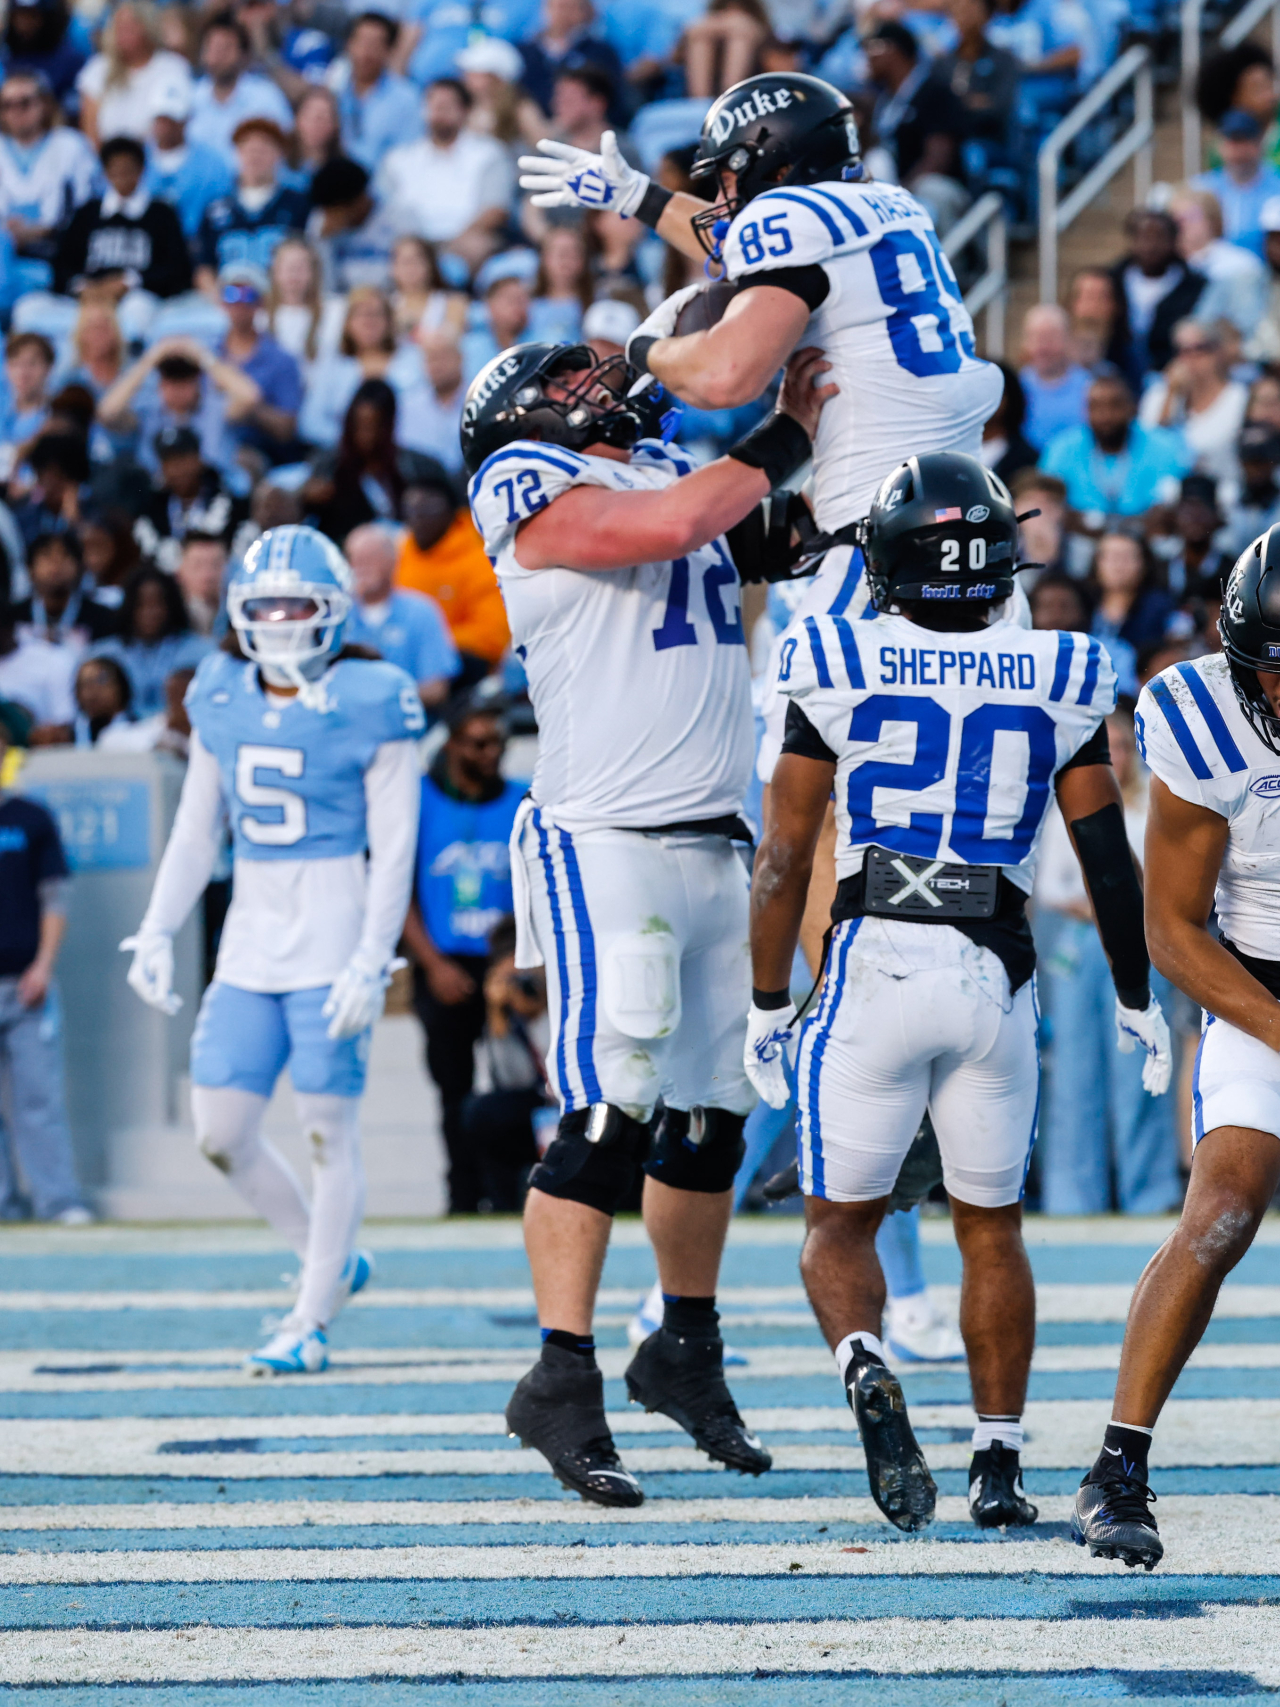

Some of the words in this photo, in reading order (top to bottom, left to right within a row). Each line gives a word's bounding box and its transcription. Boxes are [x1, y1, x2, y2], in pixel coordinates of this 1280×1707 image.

[711, 88, 792, 148] Duke
[739, 212, 793, 265] 85
[494, 469, 549, 523] 72
[940, 538, 987, 572] 20
[777, 637, 798, 682] 0
[880, 646, 1035, 691] SHEPPARD
[236, 744, 307, 844] 5
[847, 695, 1057, 866] 20
